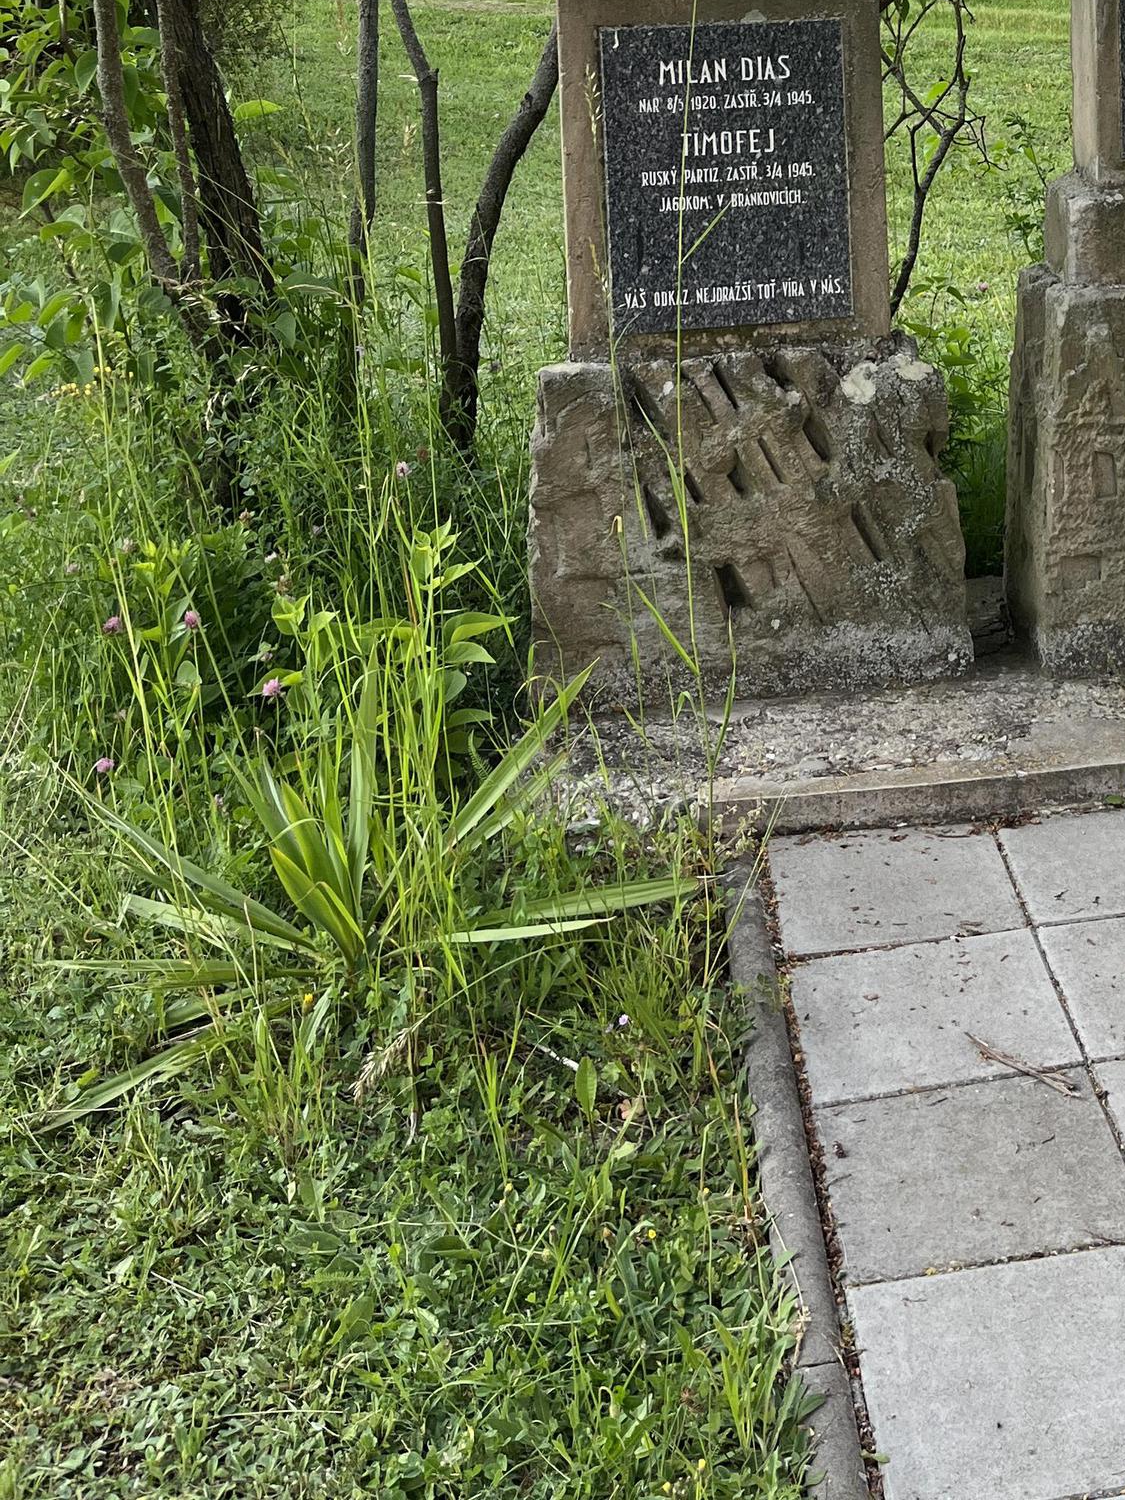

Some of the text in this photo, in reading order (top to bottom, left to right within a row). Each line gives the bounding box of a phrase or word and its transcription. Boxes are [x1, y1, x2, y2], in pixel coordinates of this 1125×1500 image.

[658, 55, 791, 87] MILAN DIAS
[667, 94, 684, 114] 8/5
[690, 95, 721, 111] 1920.
[787, 90, 816, 106] 1945.
[681, 128, 775, 157] TIMOFEJ
[641, 165, 678, 187] RUSKÝ
[684, 167, 723, 184] PARTIZ.
[766, 161, 783, 180] 3/4
[788, 161, 817, 178] 1945.
[717, 193, 725, 208] V
[782, 277, 805, 298] VÍRA
[810, 279, 819, 295] V
[821, 274, 845, 295] NÁS.
